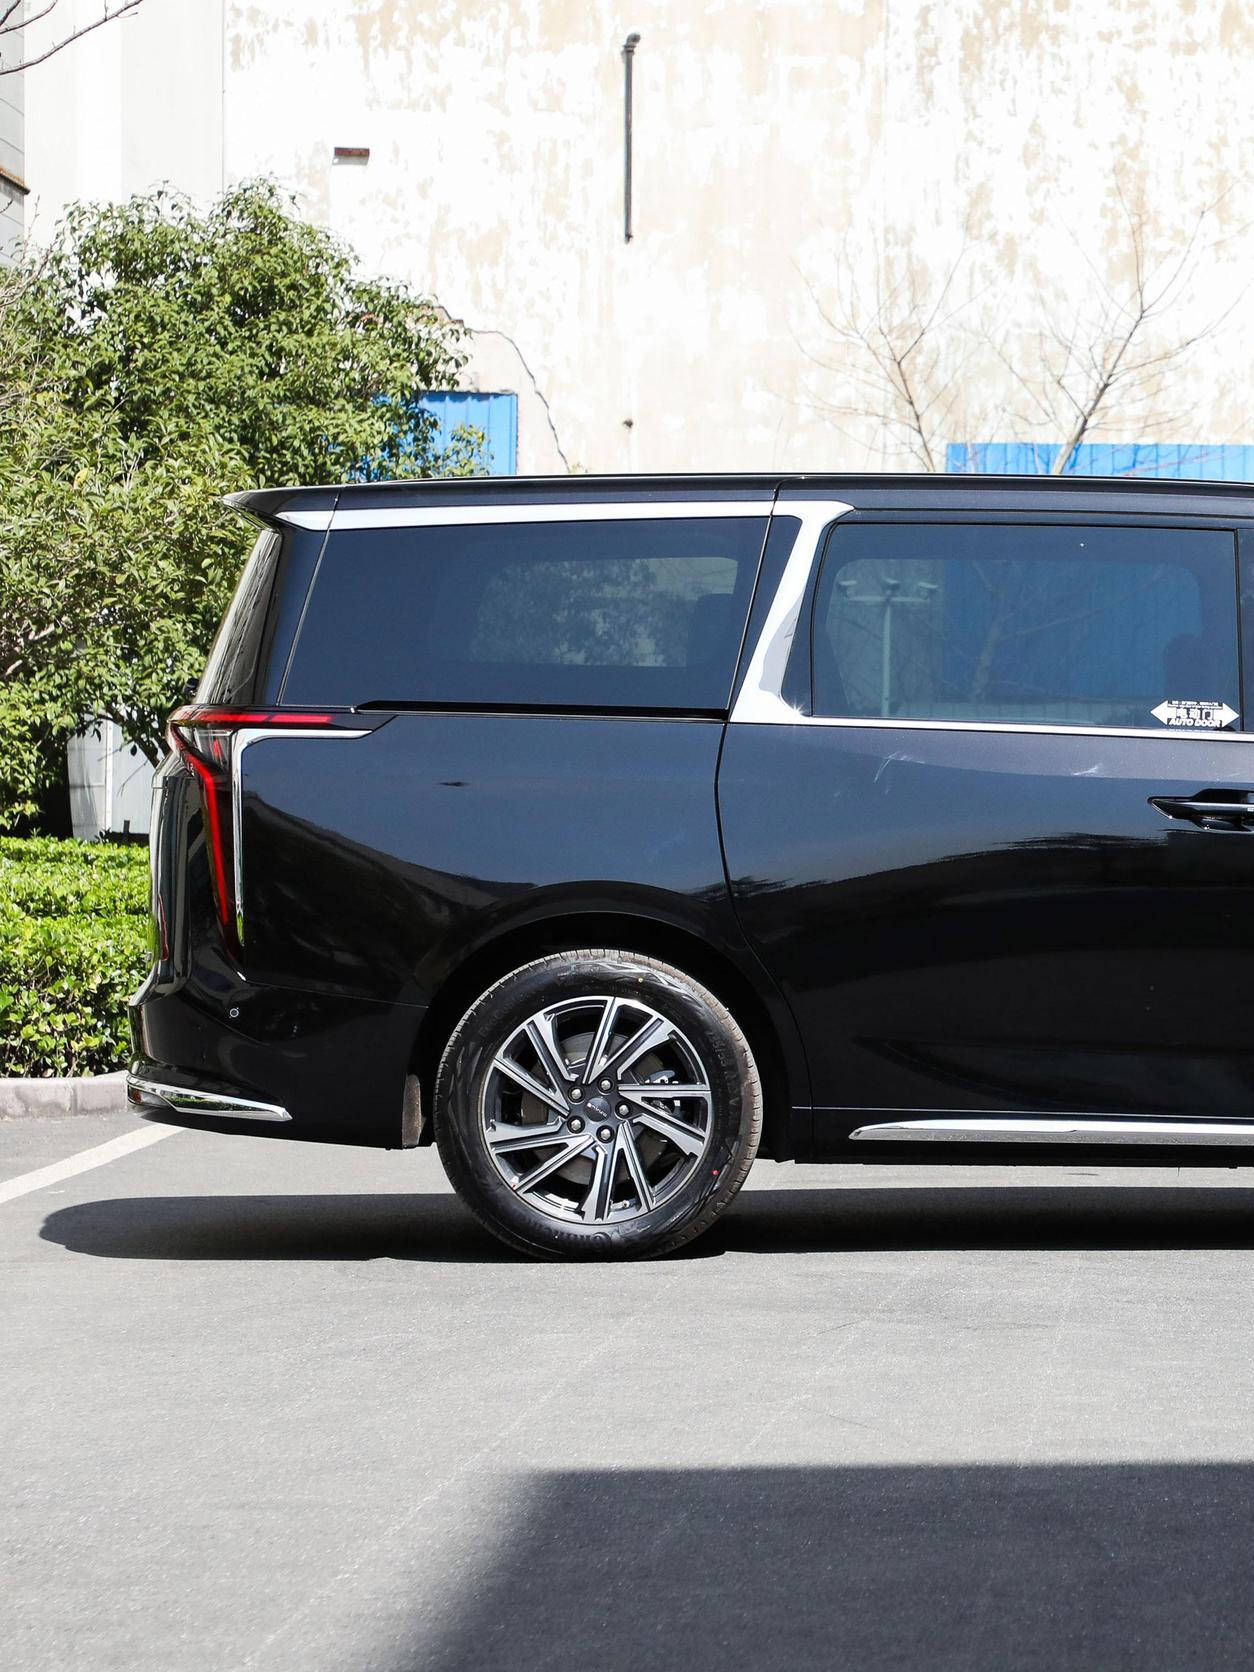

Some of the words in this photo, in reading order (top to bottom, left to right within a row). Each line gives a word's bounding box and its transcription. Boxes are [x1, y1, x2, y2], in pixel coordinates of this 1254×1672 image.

[1176, 708, 1213, 720] 电动门
[1169, 718, 1193, 726] AUTO
[1194, 719, 1221, 727] DOOR
